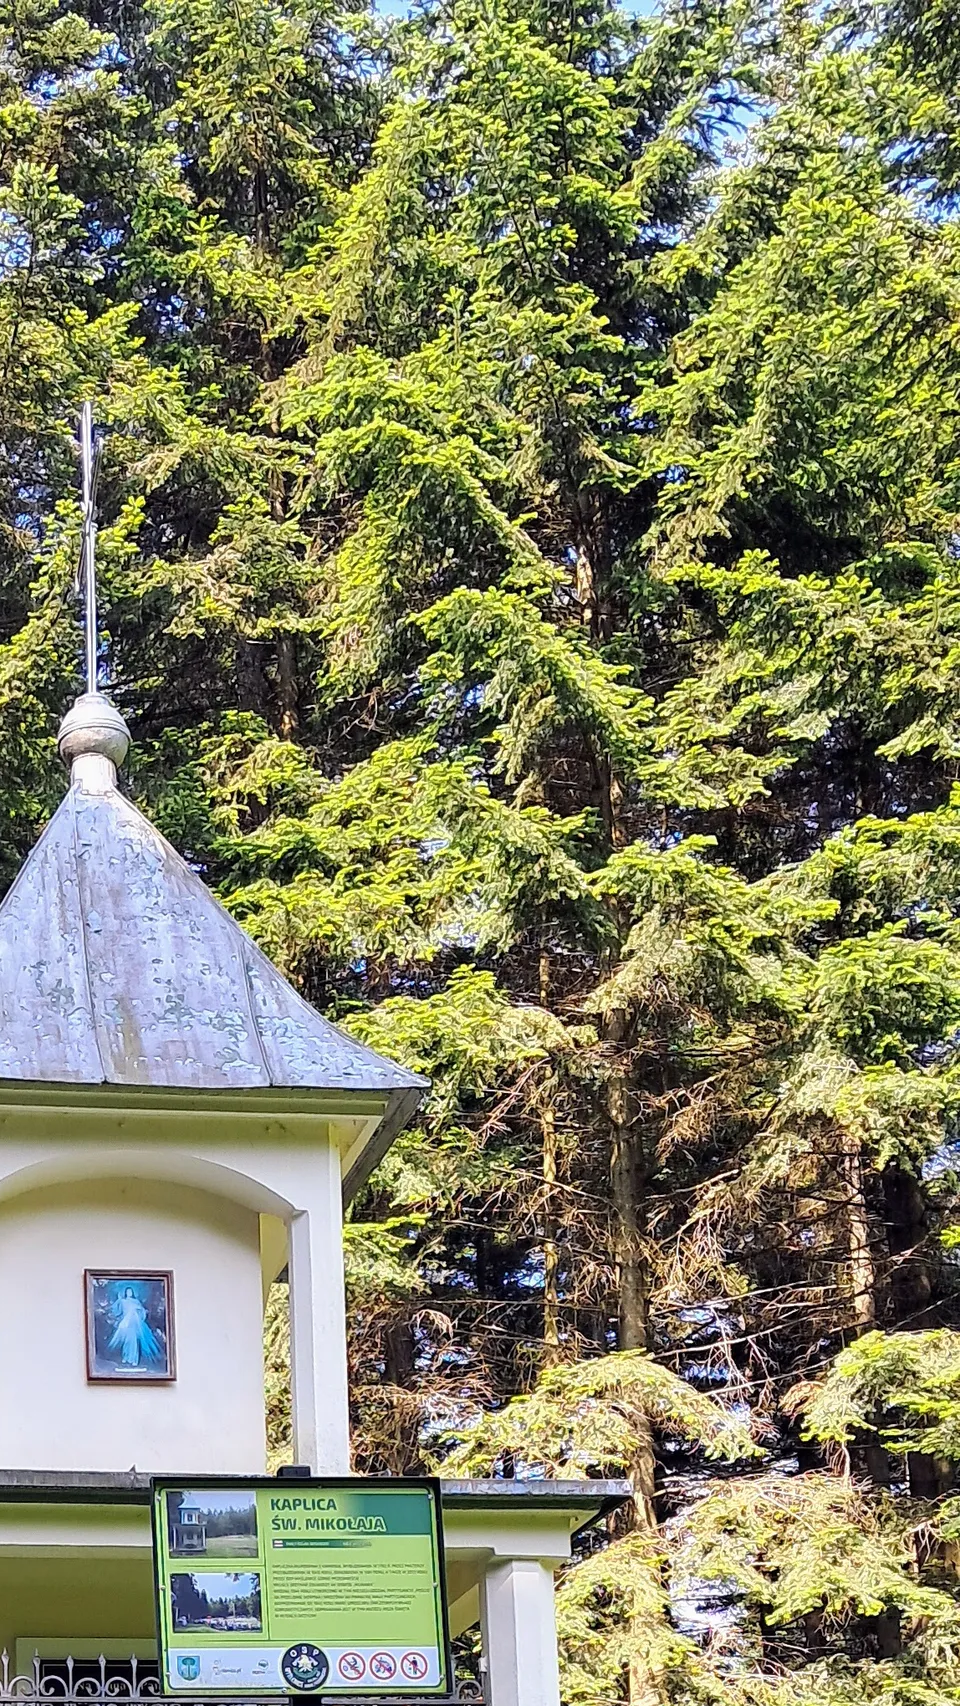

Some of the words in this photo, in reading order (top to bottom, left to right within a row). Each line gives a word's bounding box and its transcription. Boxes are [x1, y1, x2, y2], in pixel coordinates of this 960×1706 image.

[270, 1498, 337, 1511] KAPLICA
[271, 1514, 301, 1531] ŚW.
[305, 1517, 386, 1531] MIKOŁAJA
